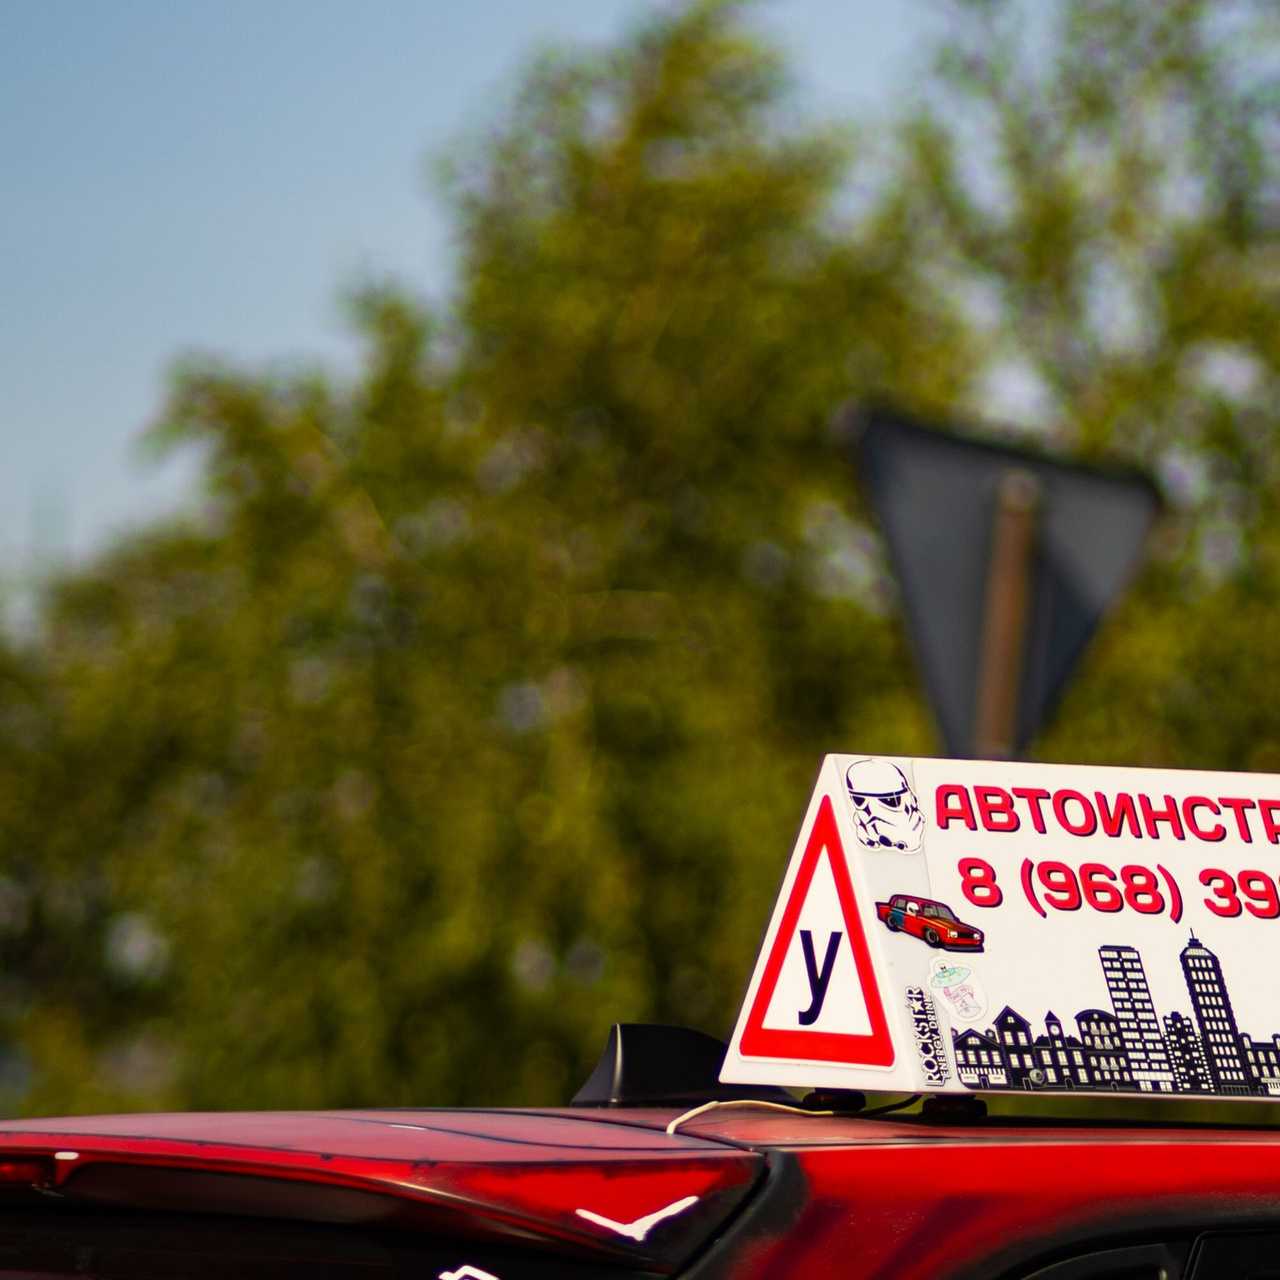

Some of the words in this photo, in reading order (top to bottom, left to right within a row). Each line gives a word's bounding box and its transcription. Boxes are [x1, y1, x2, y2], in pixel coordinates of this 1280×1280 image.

[957, 857, 1004, 909] 8
[1020, 857, 1184, 925] (968)
[931, 1032, 949, 1077] ENERGY
